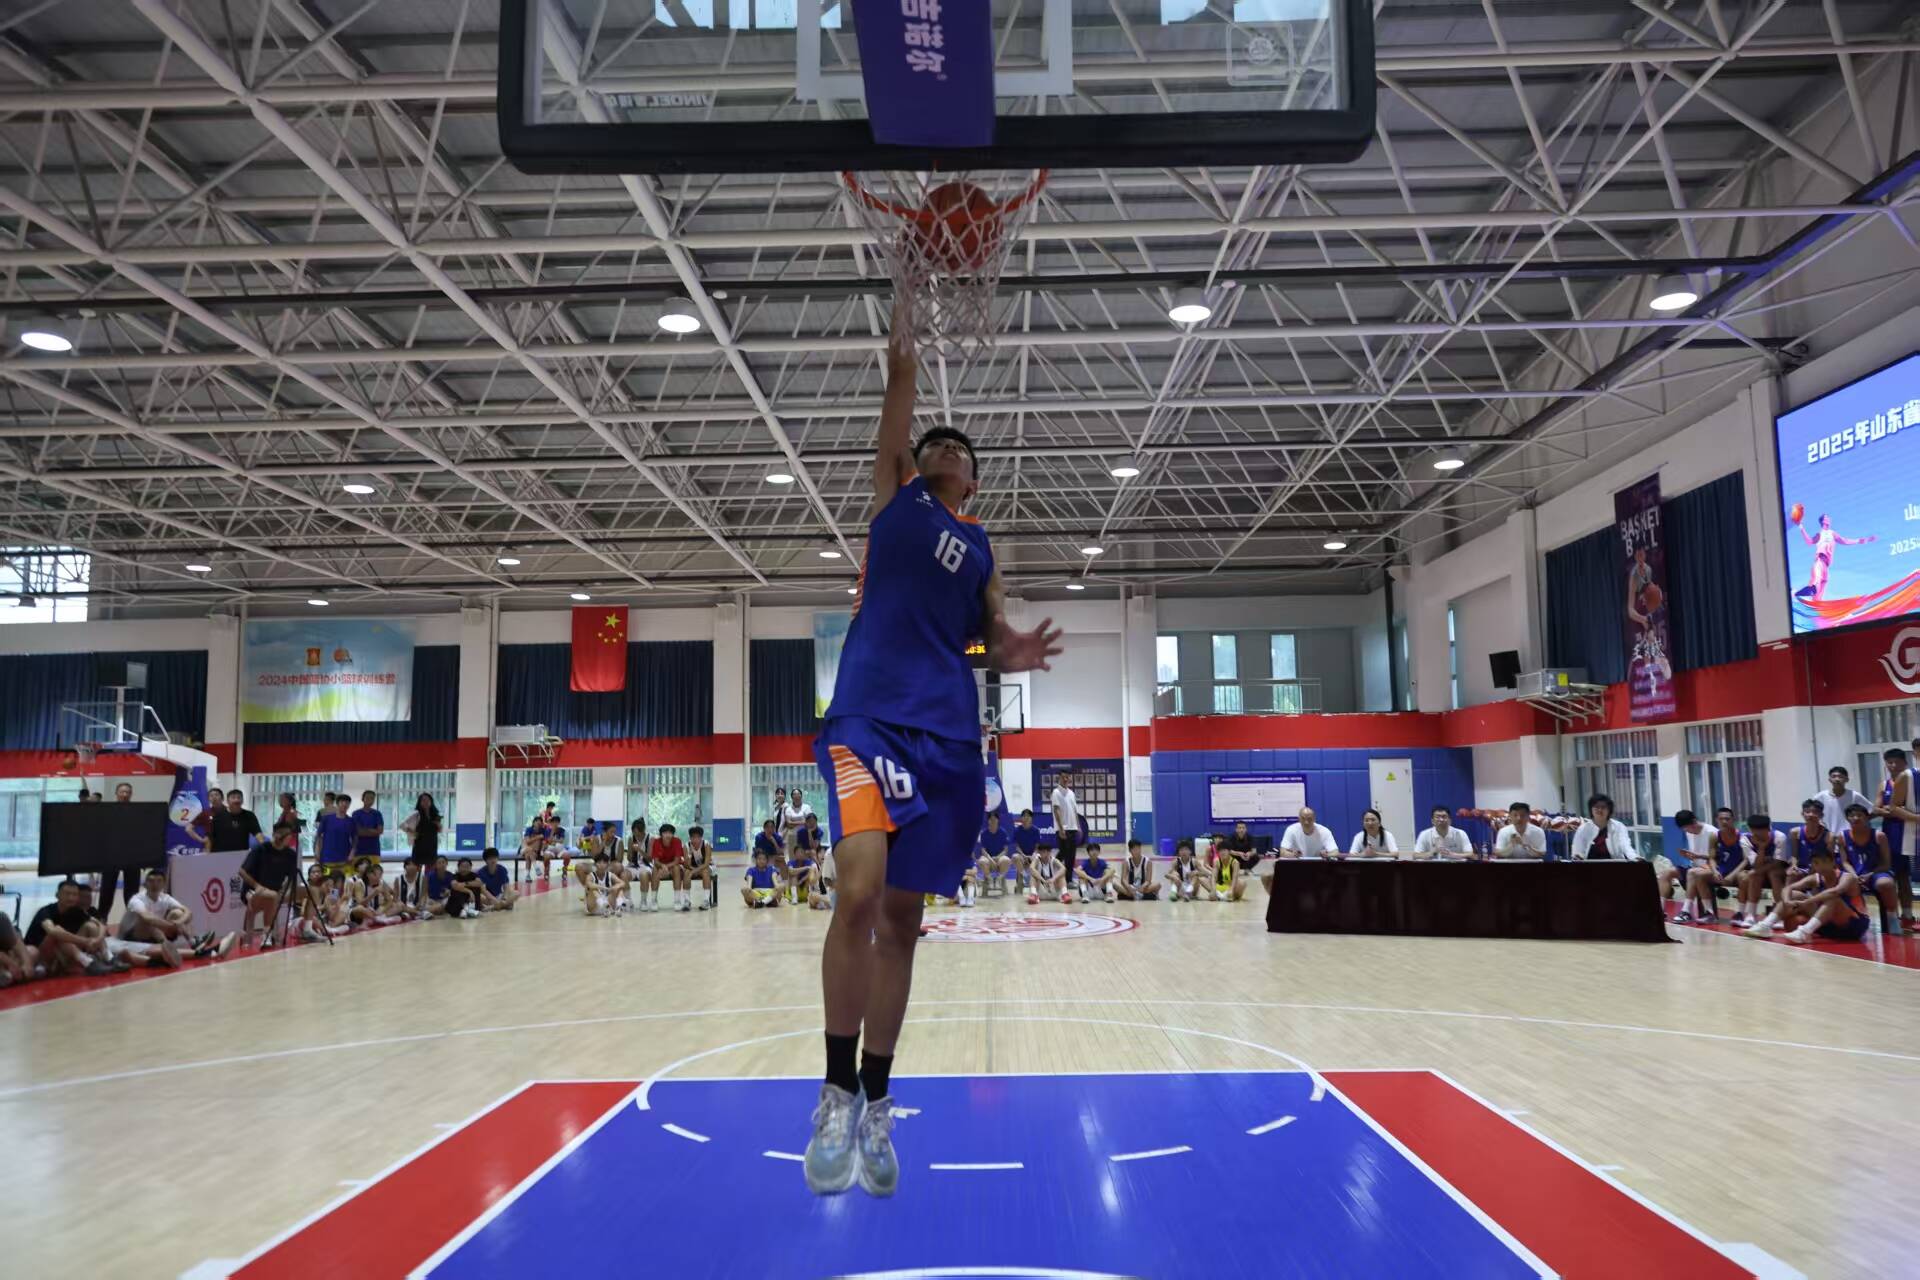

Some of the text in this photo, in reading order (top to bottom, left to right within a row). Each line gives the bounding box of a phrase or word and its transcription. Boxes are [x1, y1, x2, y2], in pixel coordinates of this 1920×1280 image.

[1620, 505, 1660, 541] BASKET
[935, 530, 967, 573] 16
[874, 756, 912, 798] 16
[180, 808, 189, 821] 2
